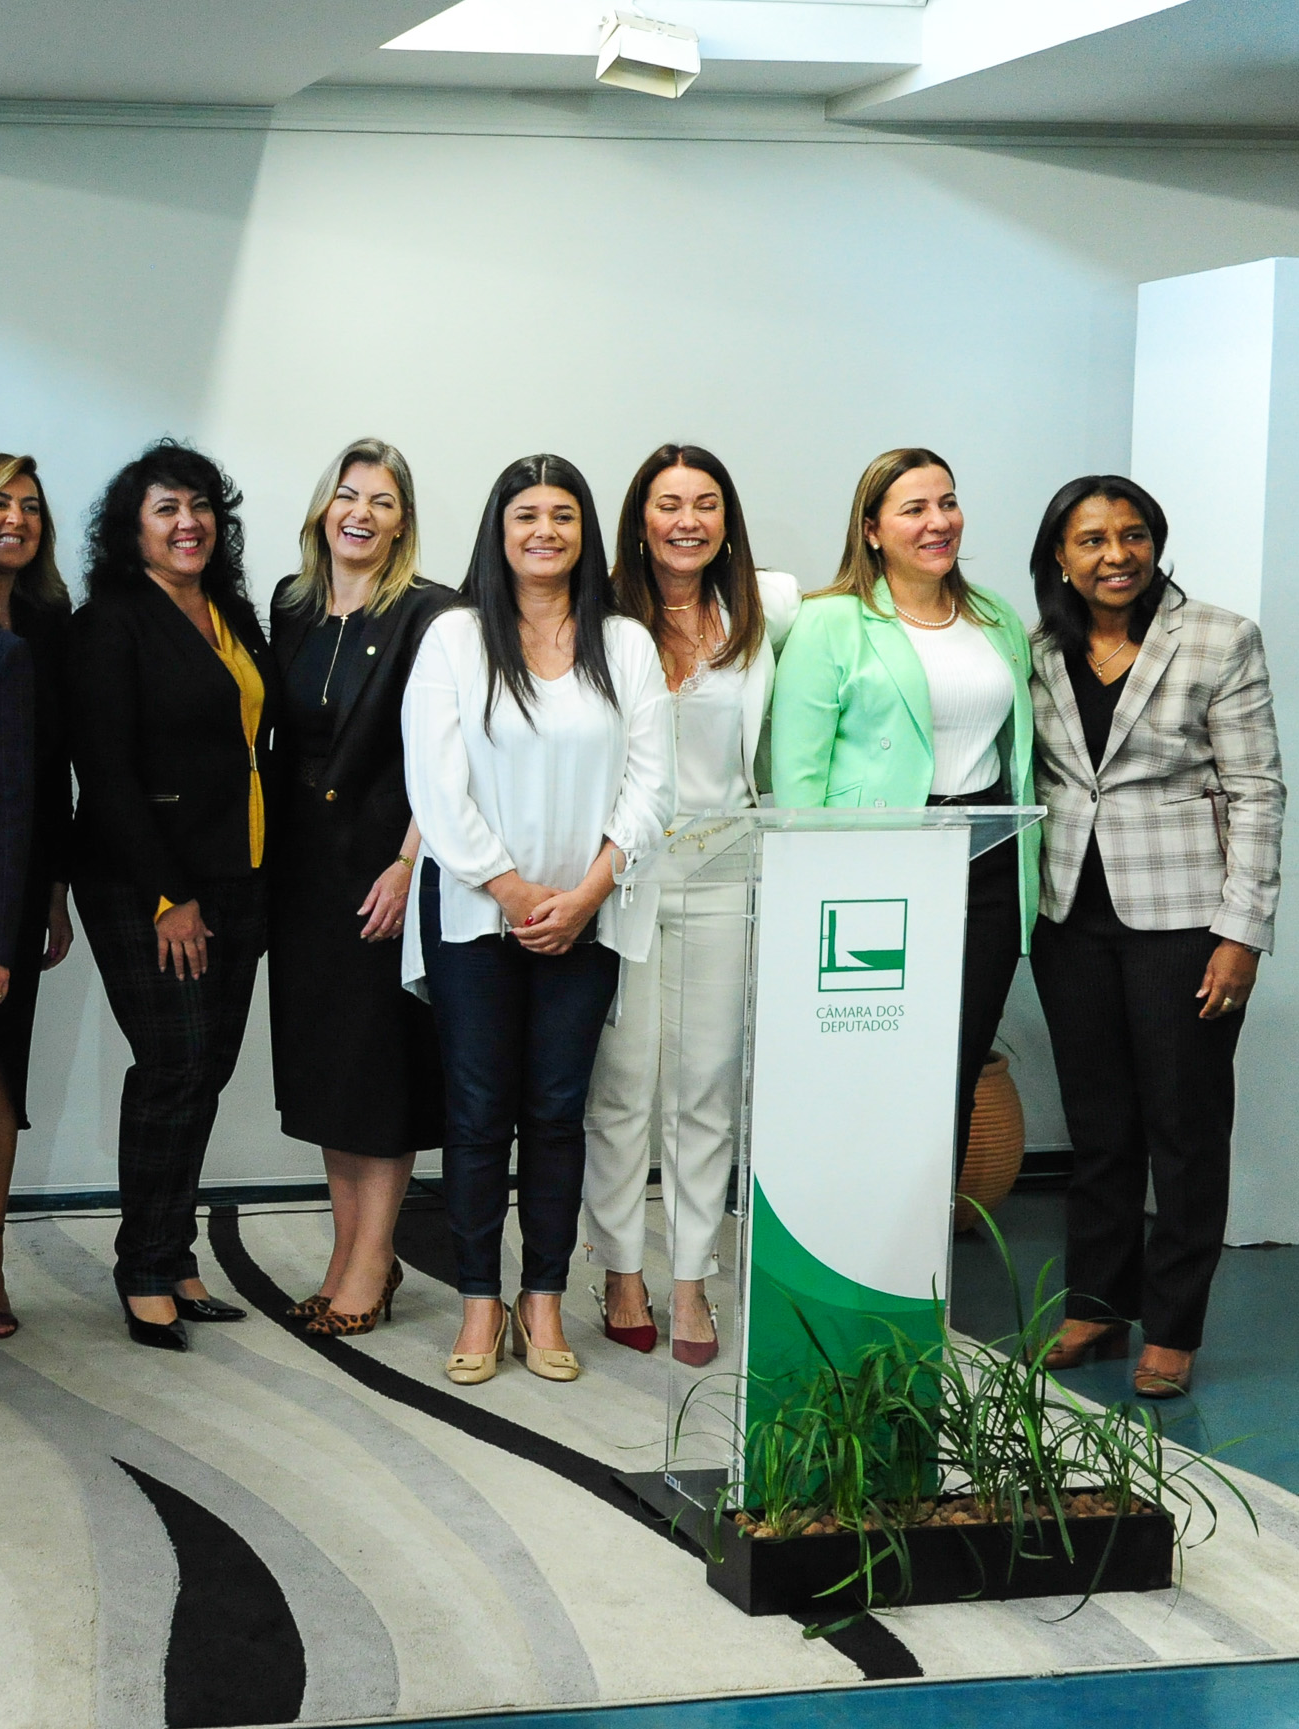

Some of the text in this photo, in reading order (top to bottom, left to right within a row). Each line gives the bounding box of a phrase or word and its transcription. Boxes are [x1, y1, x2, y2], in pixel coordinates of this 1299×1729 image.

[815, 1004, 905, 1020] CÂMARA DOS
[820, 1019, 900, 1033] DEPUTADOS
